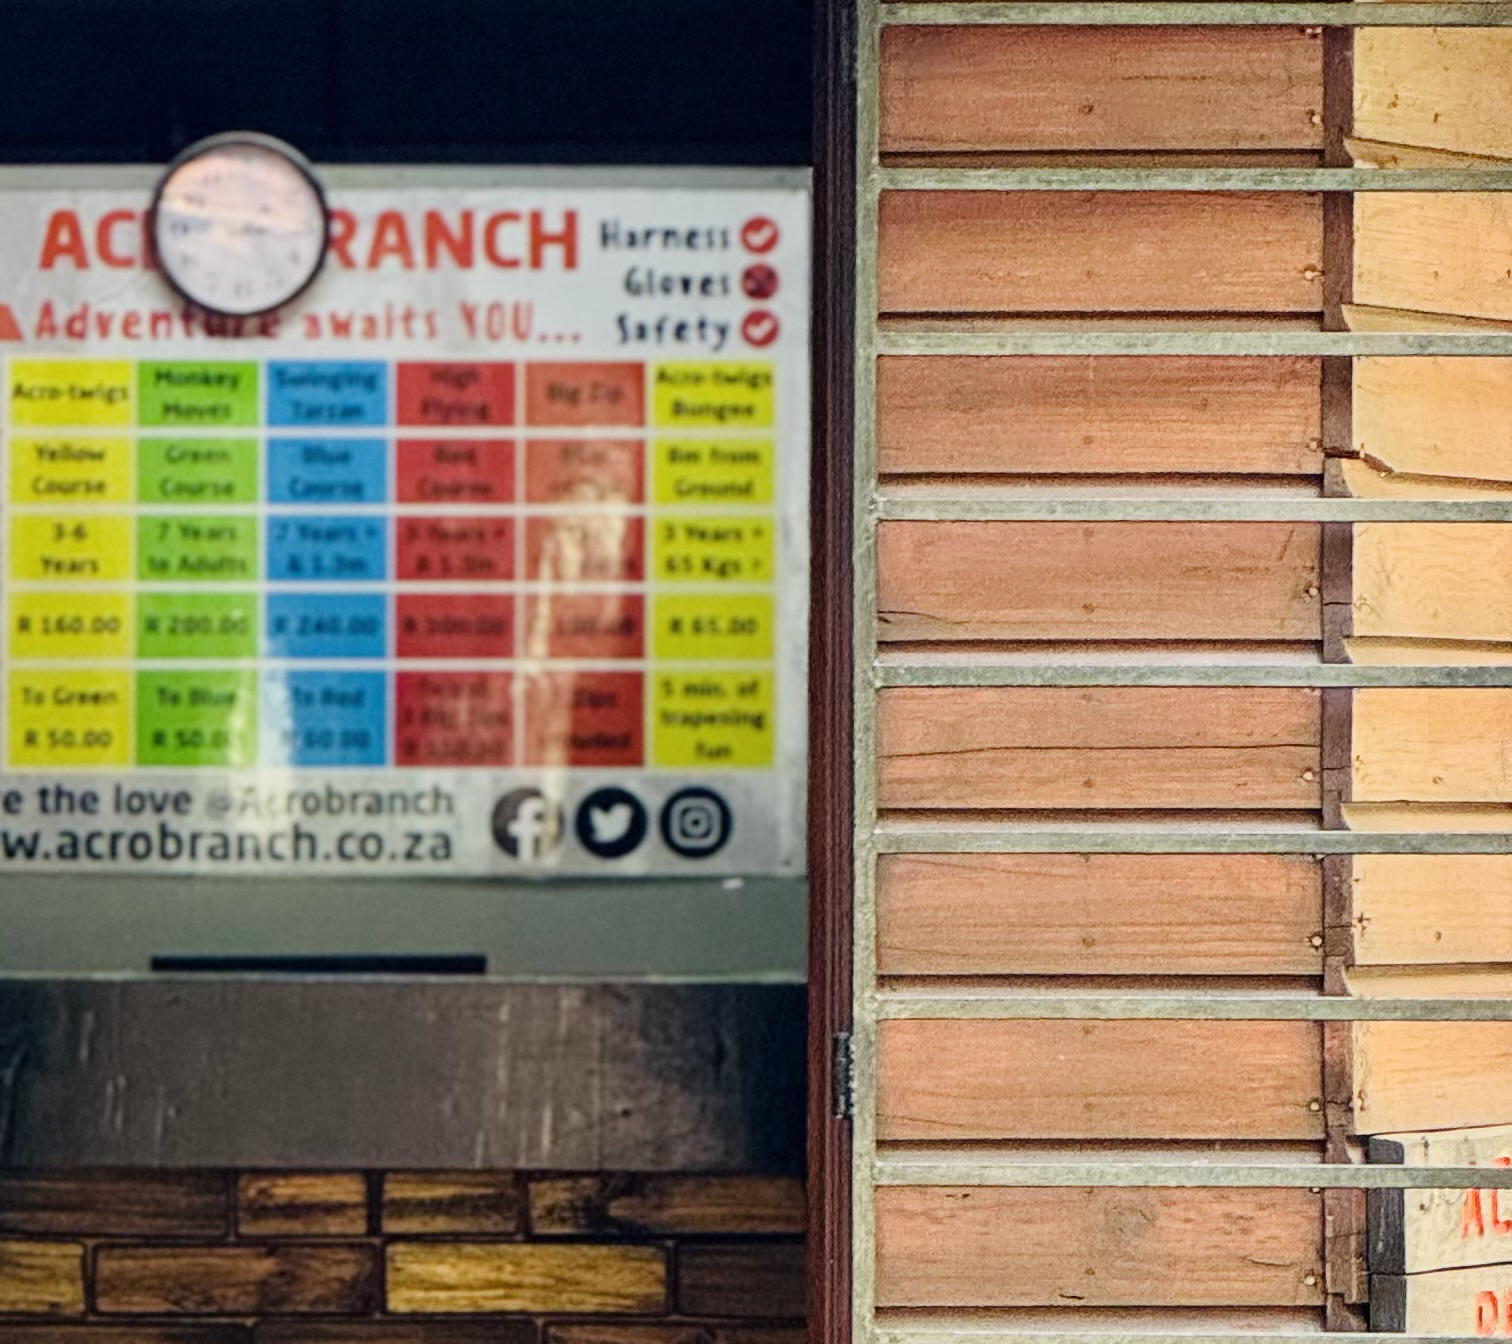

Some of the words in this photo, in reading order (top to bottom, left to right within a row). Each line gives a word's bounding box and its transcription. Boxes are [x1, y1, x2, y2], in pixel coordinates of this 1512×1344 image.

[39, 209, 578, 270] ACRANCH
[600, 219, 730, 250] Harness
[624, 266, 730, 296] Gloves
[303, 300, 437, 340] awaits
[460, 301, 581, 343] YOU...
[617, 314, 730, 351] Safety
[154, 368, 240, 392] Monkey
[13, 382, 129, 405] Acro-twigs
[35, 443, 106, 462] Yellow
[165, 445, 231, 464] Green
[31, 476, 107, 496] Course
[160, 477, 234, 497] Course
[178, 522, 237, 541] Years
[41, 556, 100, 574] Years
[18, 616, 31, 633] R
[42, 616, 120, 635] 160.00
[22, 687, 45, 705] To
[52, 686, 120, 706] Green
[24, 730, 38, 748] R
[47, 730, 114, 749] 50.00
[38, 783, 100, 815] the
[114, 784, 191, 815] love
